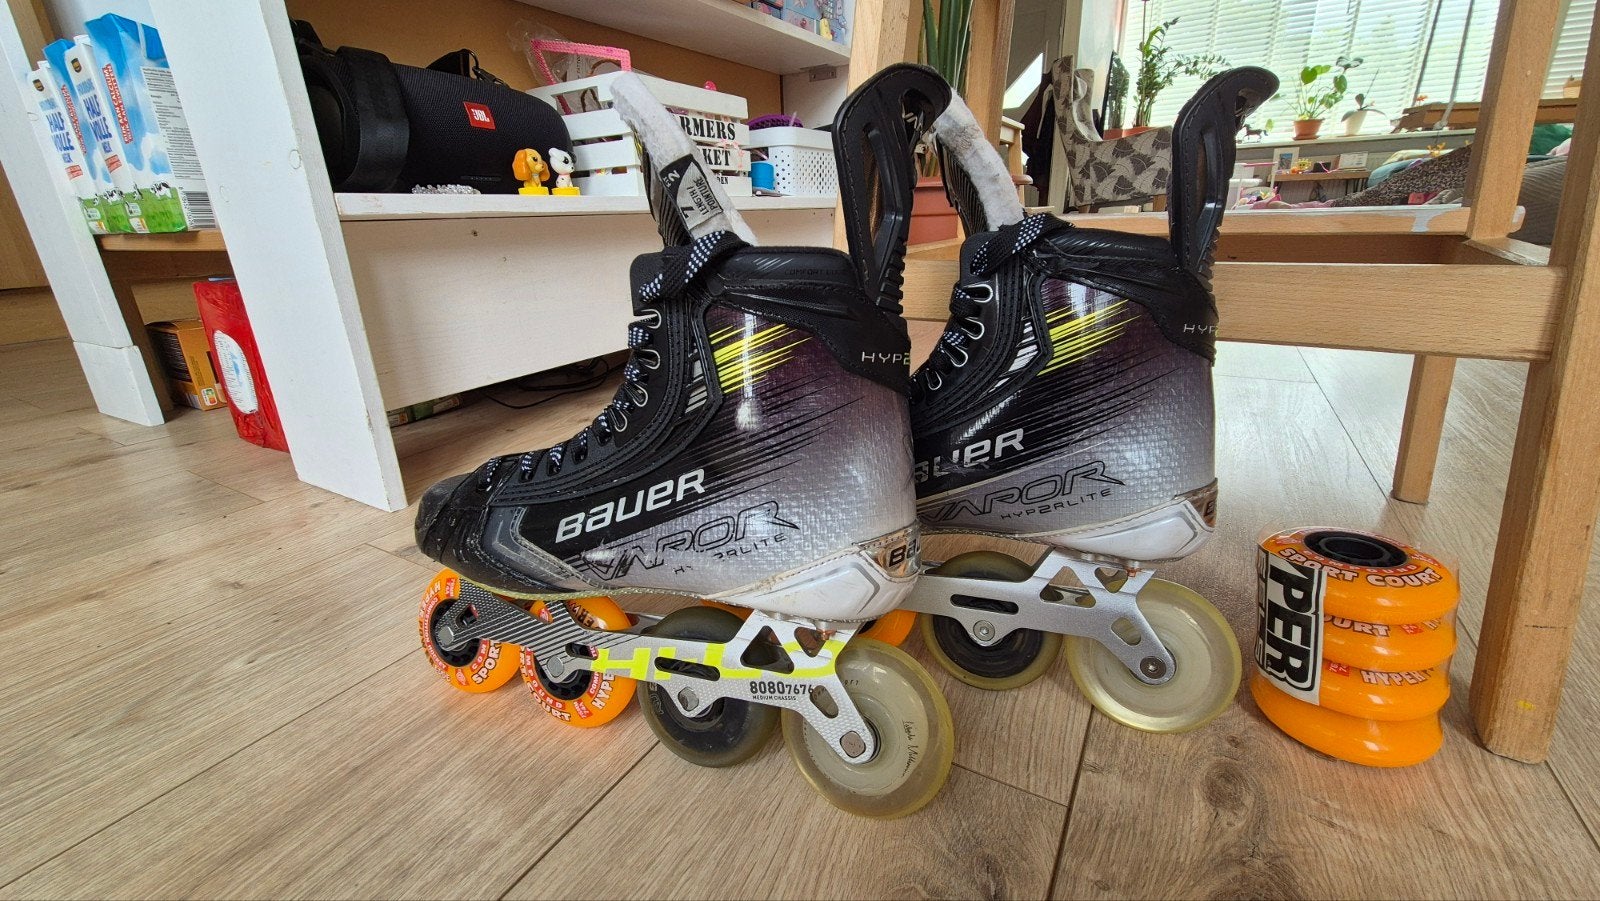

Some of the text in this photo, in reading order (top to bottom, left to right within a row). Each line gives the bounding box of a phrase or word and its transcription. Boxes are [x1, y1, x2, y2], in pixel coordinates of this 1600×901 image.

[83, 94, 101, 120] HALF
[470, 107, 492, 123] JBL
[679, 115, 736, 141] RMERS
[700, 148, 731, 166] KET
[679, 205, 695, 219] 7
[555, 468, 706, 544] BAUER
[1279, 547, 1444, 588] SPORT COURT
[471, 640, 501, 685] SPORT
[526, 681, 572, 722] COURT
